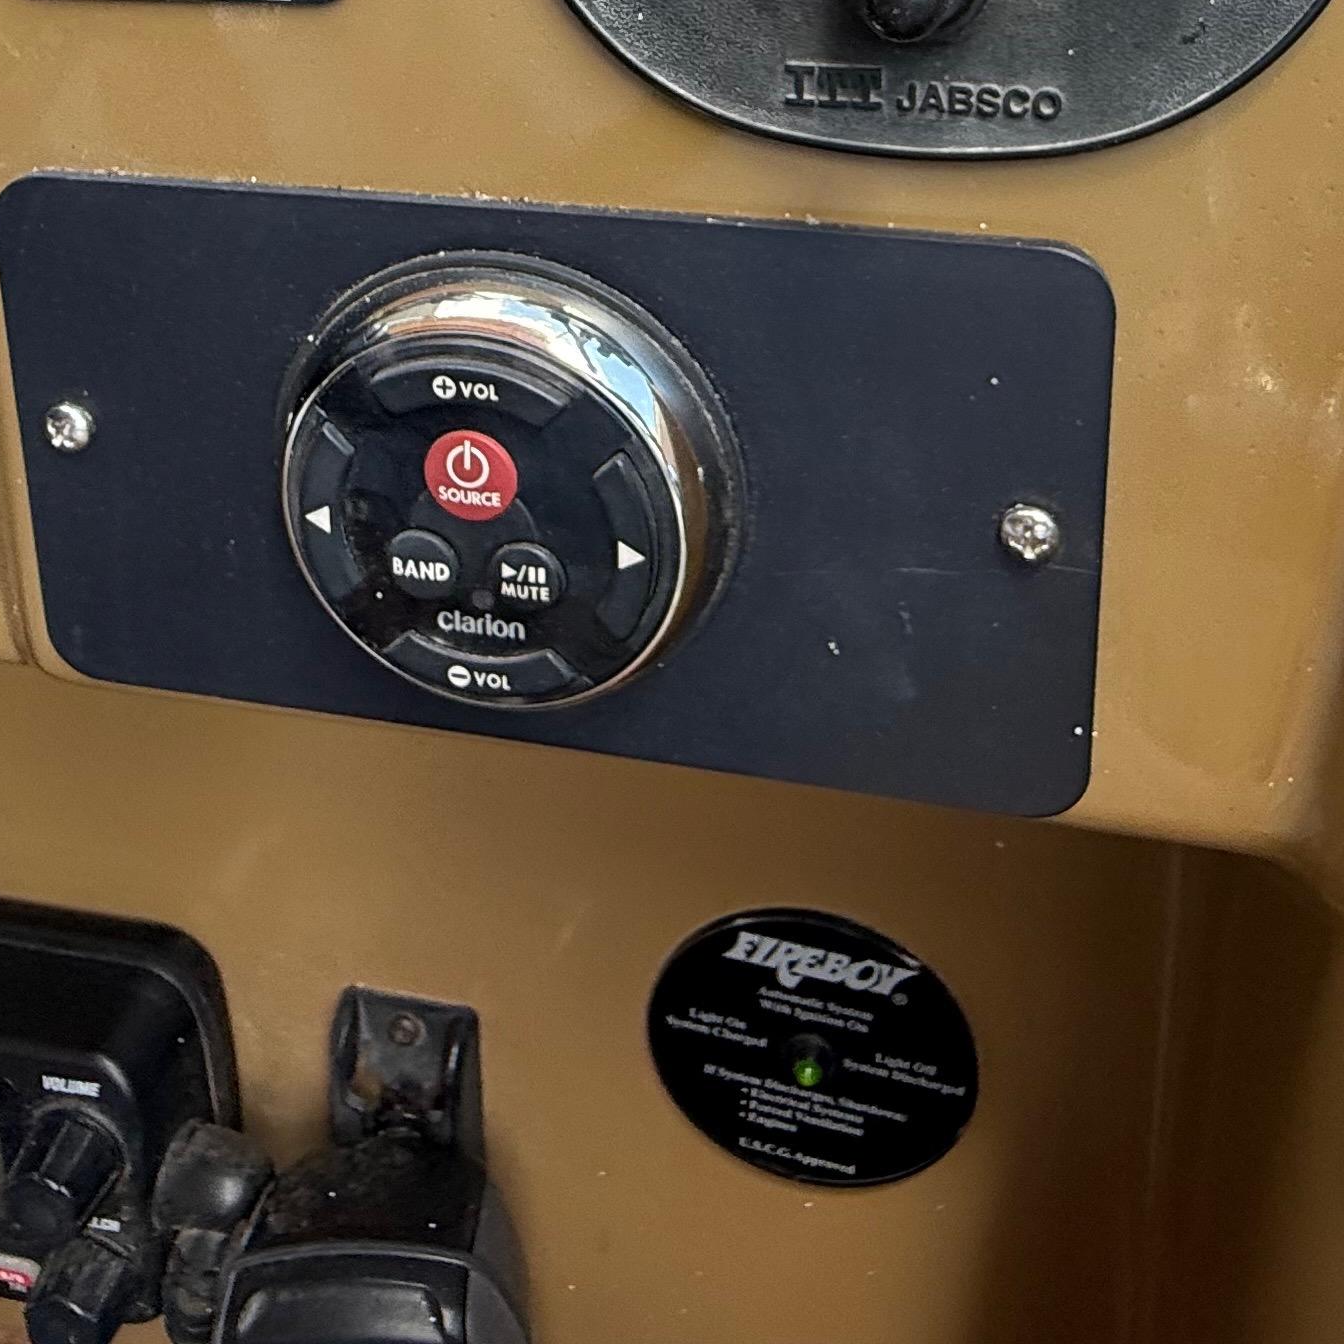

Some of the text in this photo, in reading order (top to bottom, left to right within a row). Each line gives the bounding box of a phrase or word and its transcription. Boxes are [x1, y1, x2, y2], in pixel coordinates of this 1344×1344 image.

[896, 81, 1064, 121] JABSCO
[459, 380, 499, 401] VOL
[438, 485, 502, 507] SOURCE
[392, 557, 450, 582] BAND
[500, 582, 550, 602] MUTE
[474, 669, 511, 691] VOL
[722, 930, 921, 997] FIREBOY
[41, 1074, 103, 1098] VOLUME
